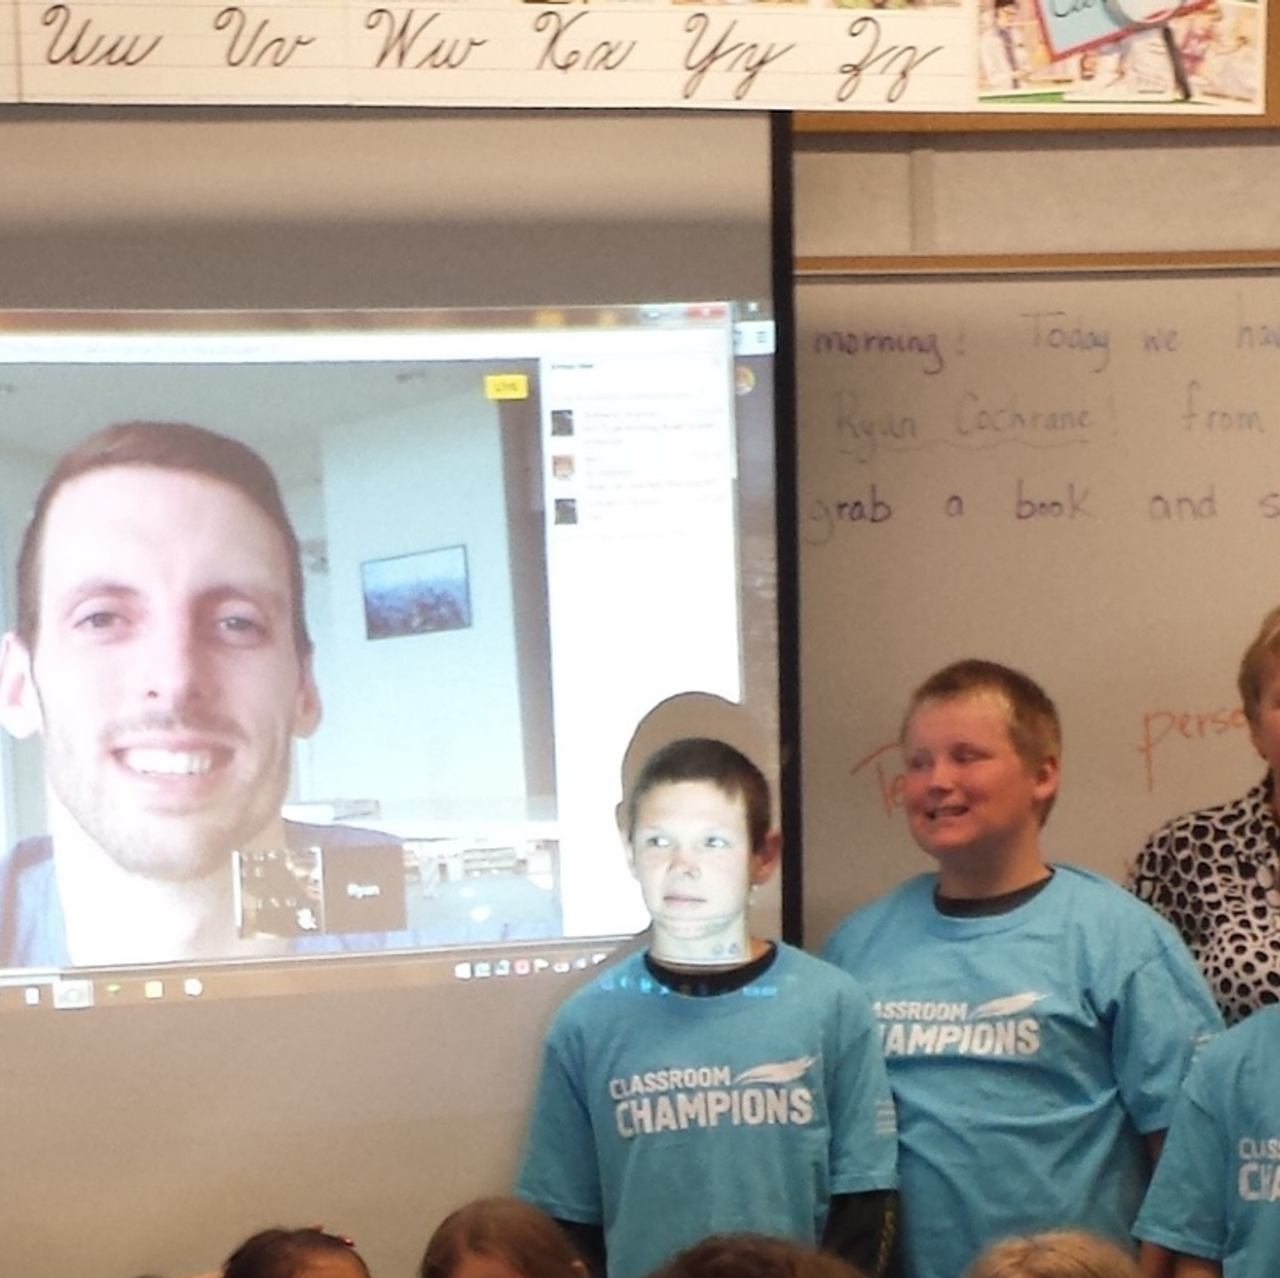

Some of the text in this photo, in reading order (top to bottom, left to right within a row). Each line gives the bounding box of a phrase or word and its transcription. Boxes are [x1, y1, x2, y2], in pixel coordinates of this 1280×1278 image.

[40, 4, 164, 66] Uu
[213, 6, 317, 68] Vv
[365, 8, 490, 70] Ww
[533, 10, 637, 73] Xx
[683, 12, 797, 100] Yy
[839, 15, 945, 103] Zz
[1020, 311, 1111, 374] Today
[1181, 380, 1265, 434] from
[946, 494, 964, 519] a
[1015, 479, 1091, 520] book
[1149, 484, 1217, 520] and
[872, 1000, 969, 1021] ASSROOM
[609, 1065, 731, 1100] CLASSROOM
[615, 1086, 815, 1139] CHAMPIONS
